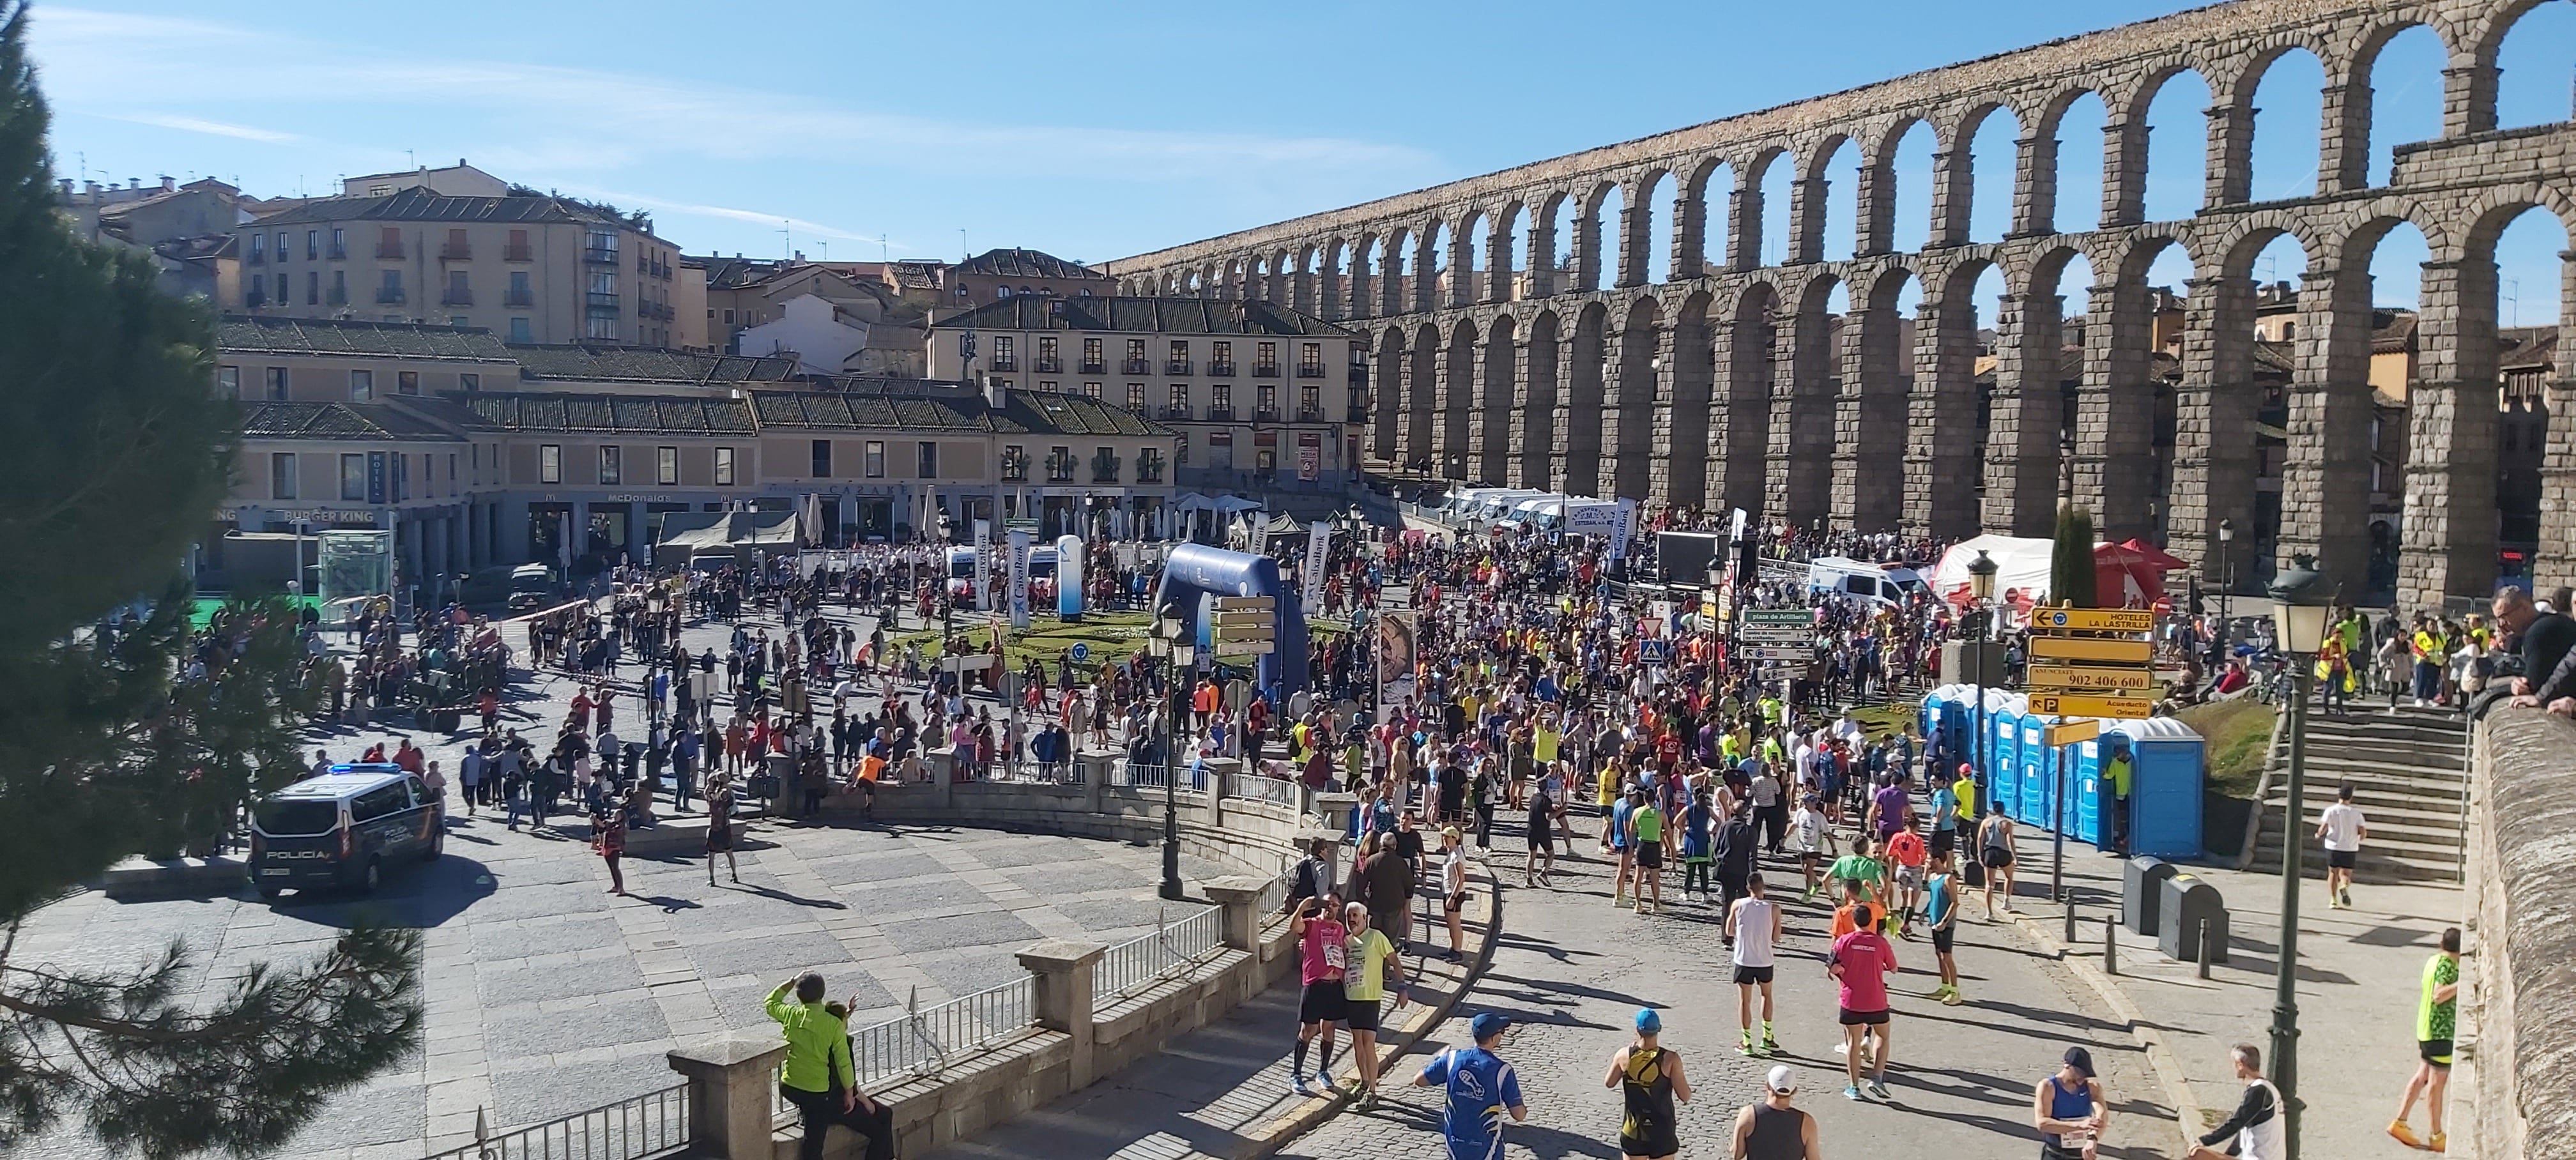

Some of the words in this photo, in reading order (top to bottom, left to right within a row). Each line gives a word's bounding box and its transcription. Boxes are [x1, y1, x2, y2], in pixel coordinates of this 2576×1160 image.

[373, 454, 381, 490] HOTEL
[608, 494, 671, 503] McDonald's
[284, 511, 336, 522] BURGER
[340, 511, 374, 523] KING
[1614, 508, 1630, 551] CaixaBank
[1308, 534, 1326, 585] CaixaBank
[1014, 544, 1023, 599] CaixaBank
[1752, 612, 1769, 620] plaza
[2110, 614, 2151, 622] HOTELES
[2103, 620, 2150, 629] LASTRILLA
[2069, 675, 2091, 685] 902
[2094, 676, 2117, 687] 406
[2120, 677, 2143, 688] 600
[2046, 700, 2056, 711] P
[2106, 700, 2147, 708] Acueducto
